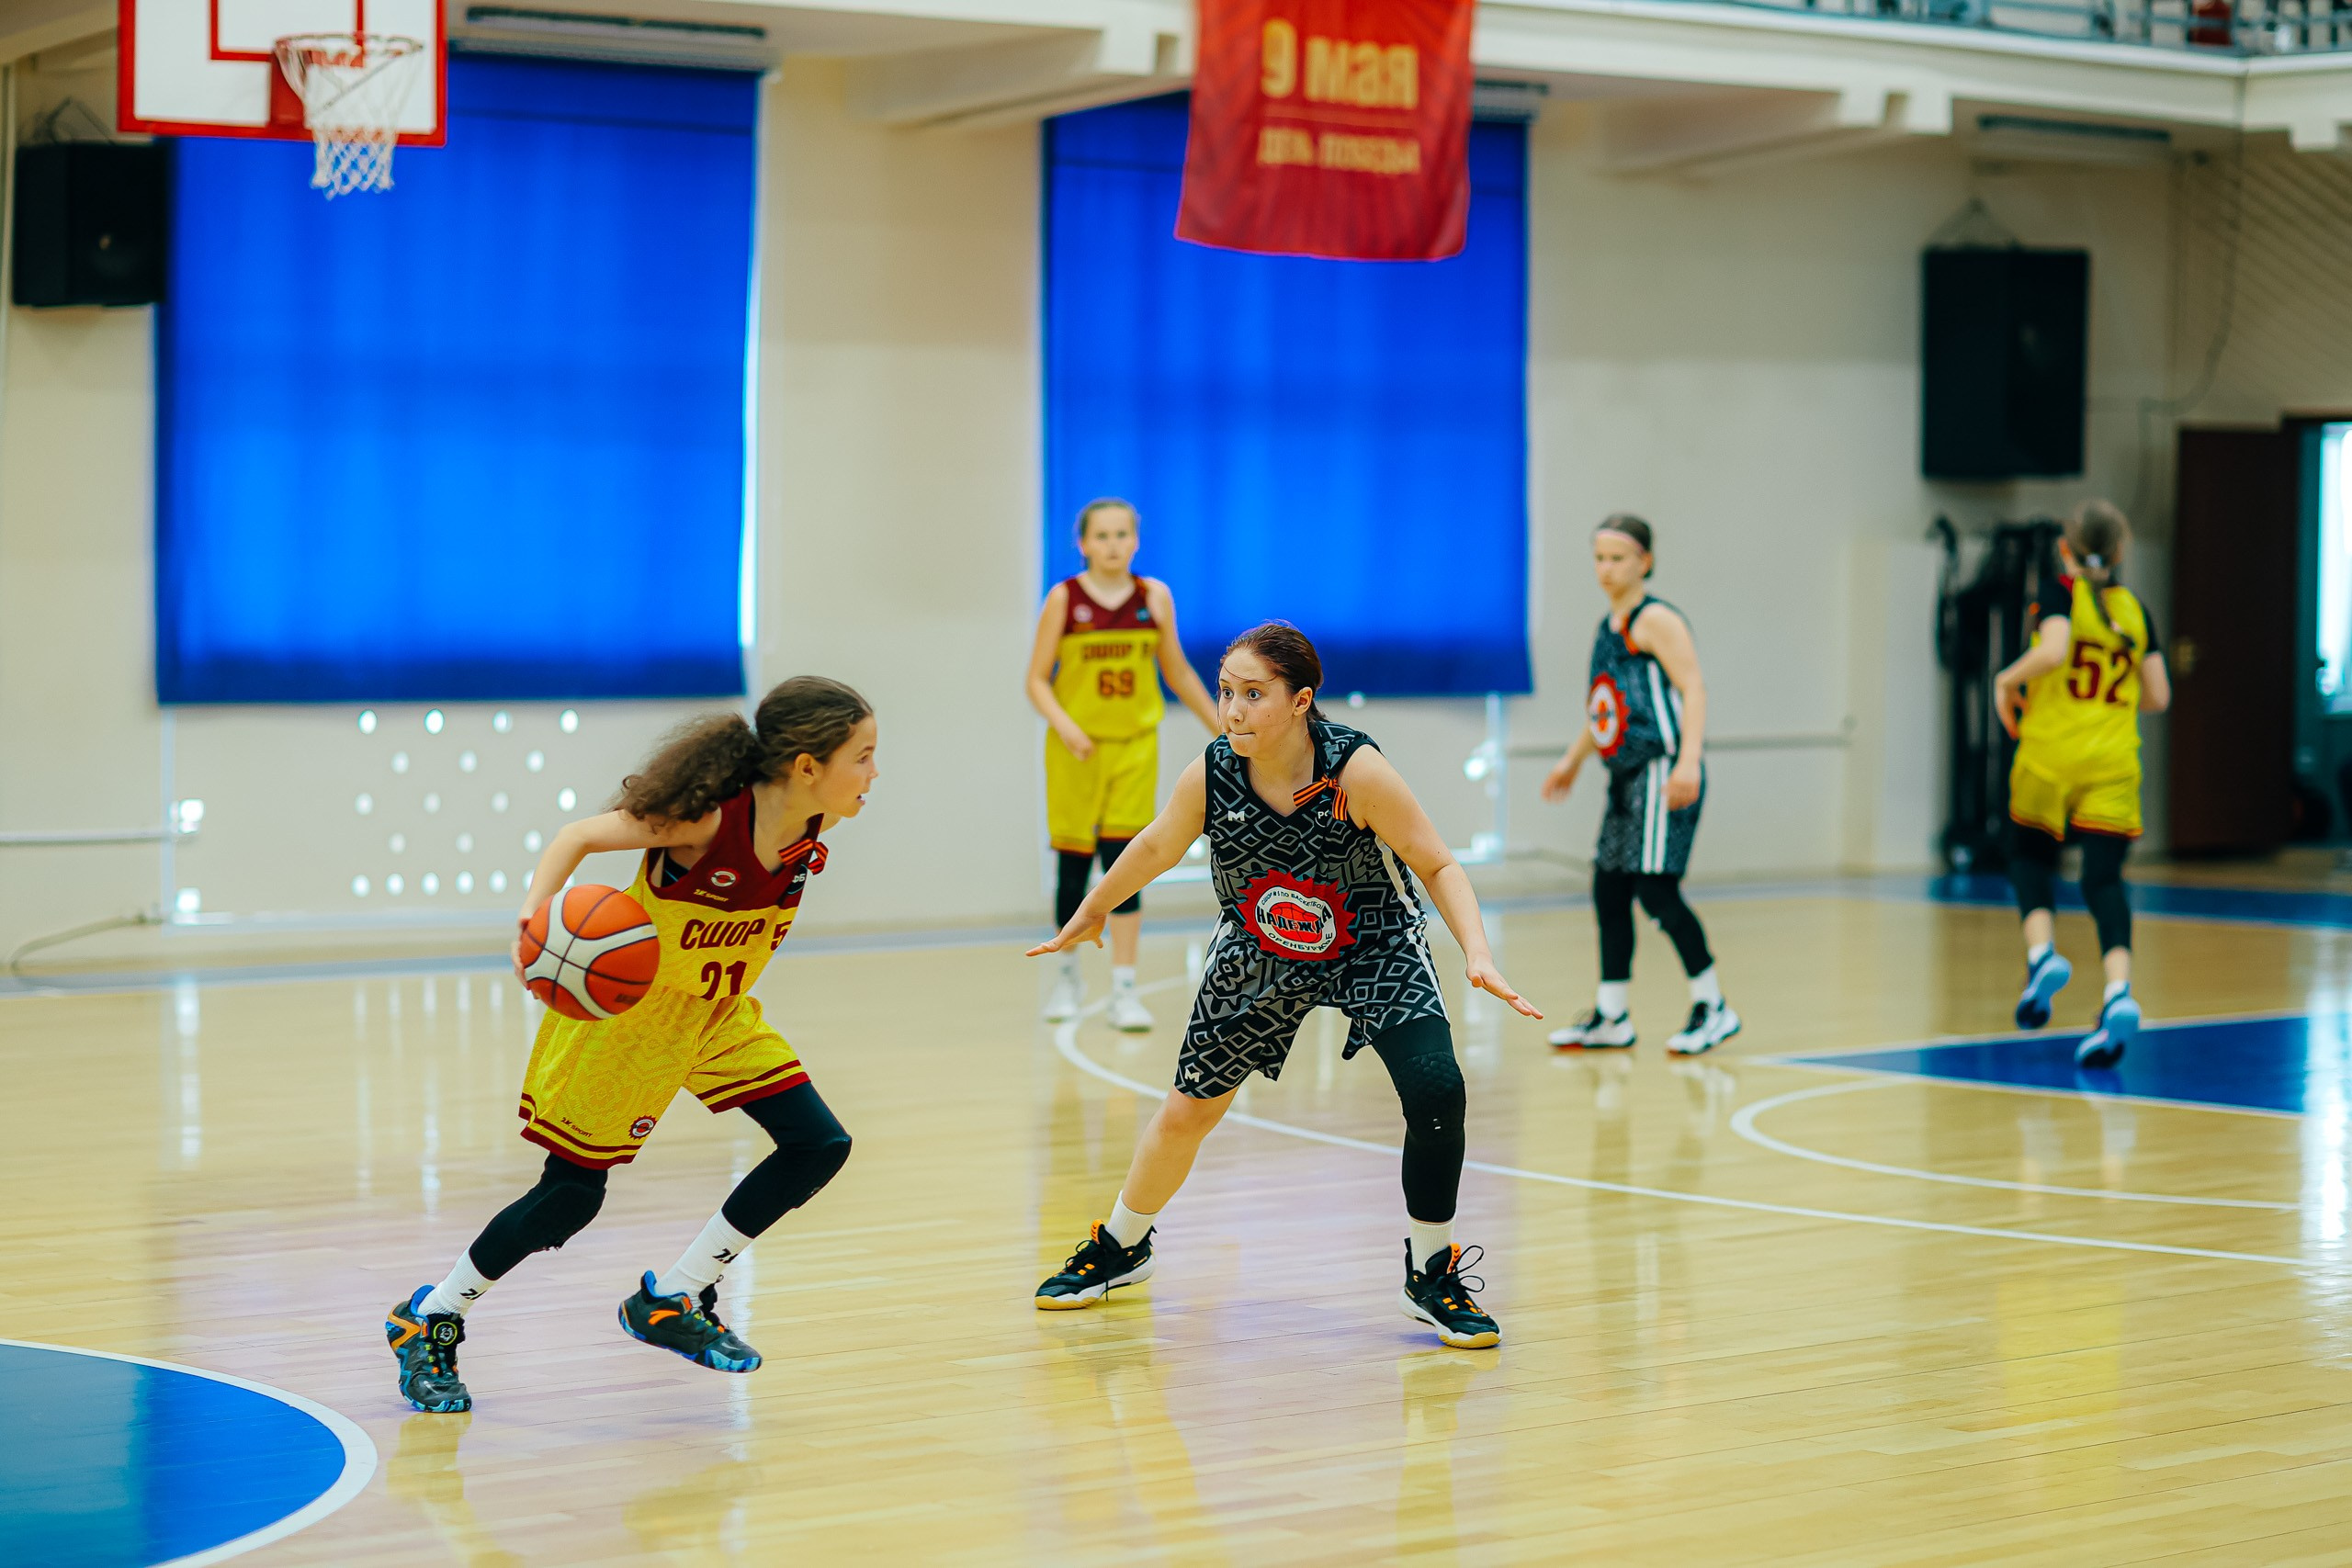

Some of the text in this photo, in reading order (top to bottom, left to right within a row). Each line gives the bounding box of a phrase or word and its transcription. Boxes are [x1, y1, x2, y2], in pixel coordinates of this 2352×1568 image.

[1261, 18, 1419, 110] 9 мая
[1100, 670, 1135, 698] 69
[2069, 640, 2132, 707] 52
[680, 919, 792, 951] СШОР 5
[699, 960, 747, 1001] 21
